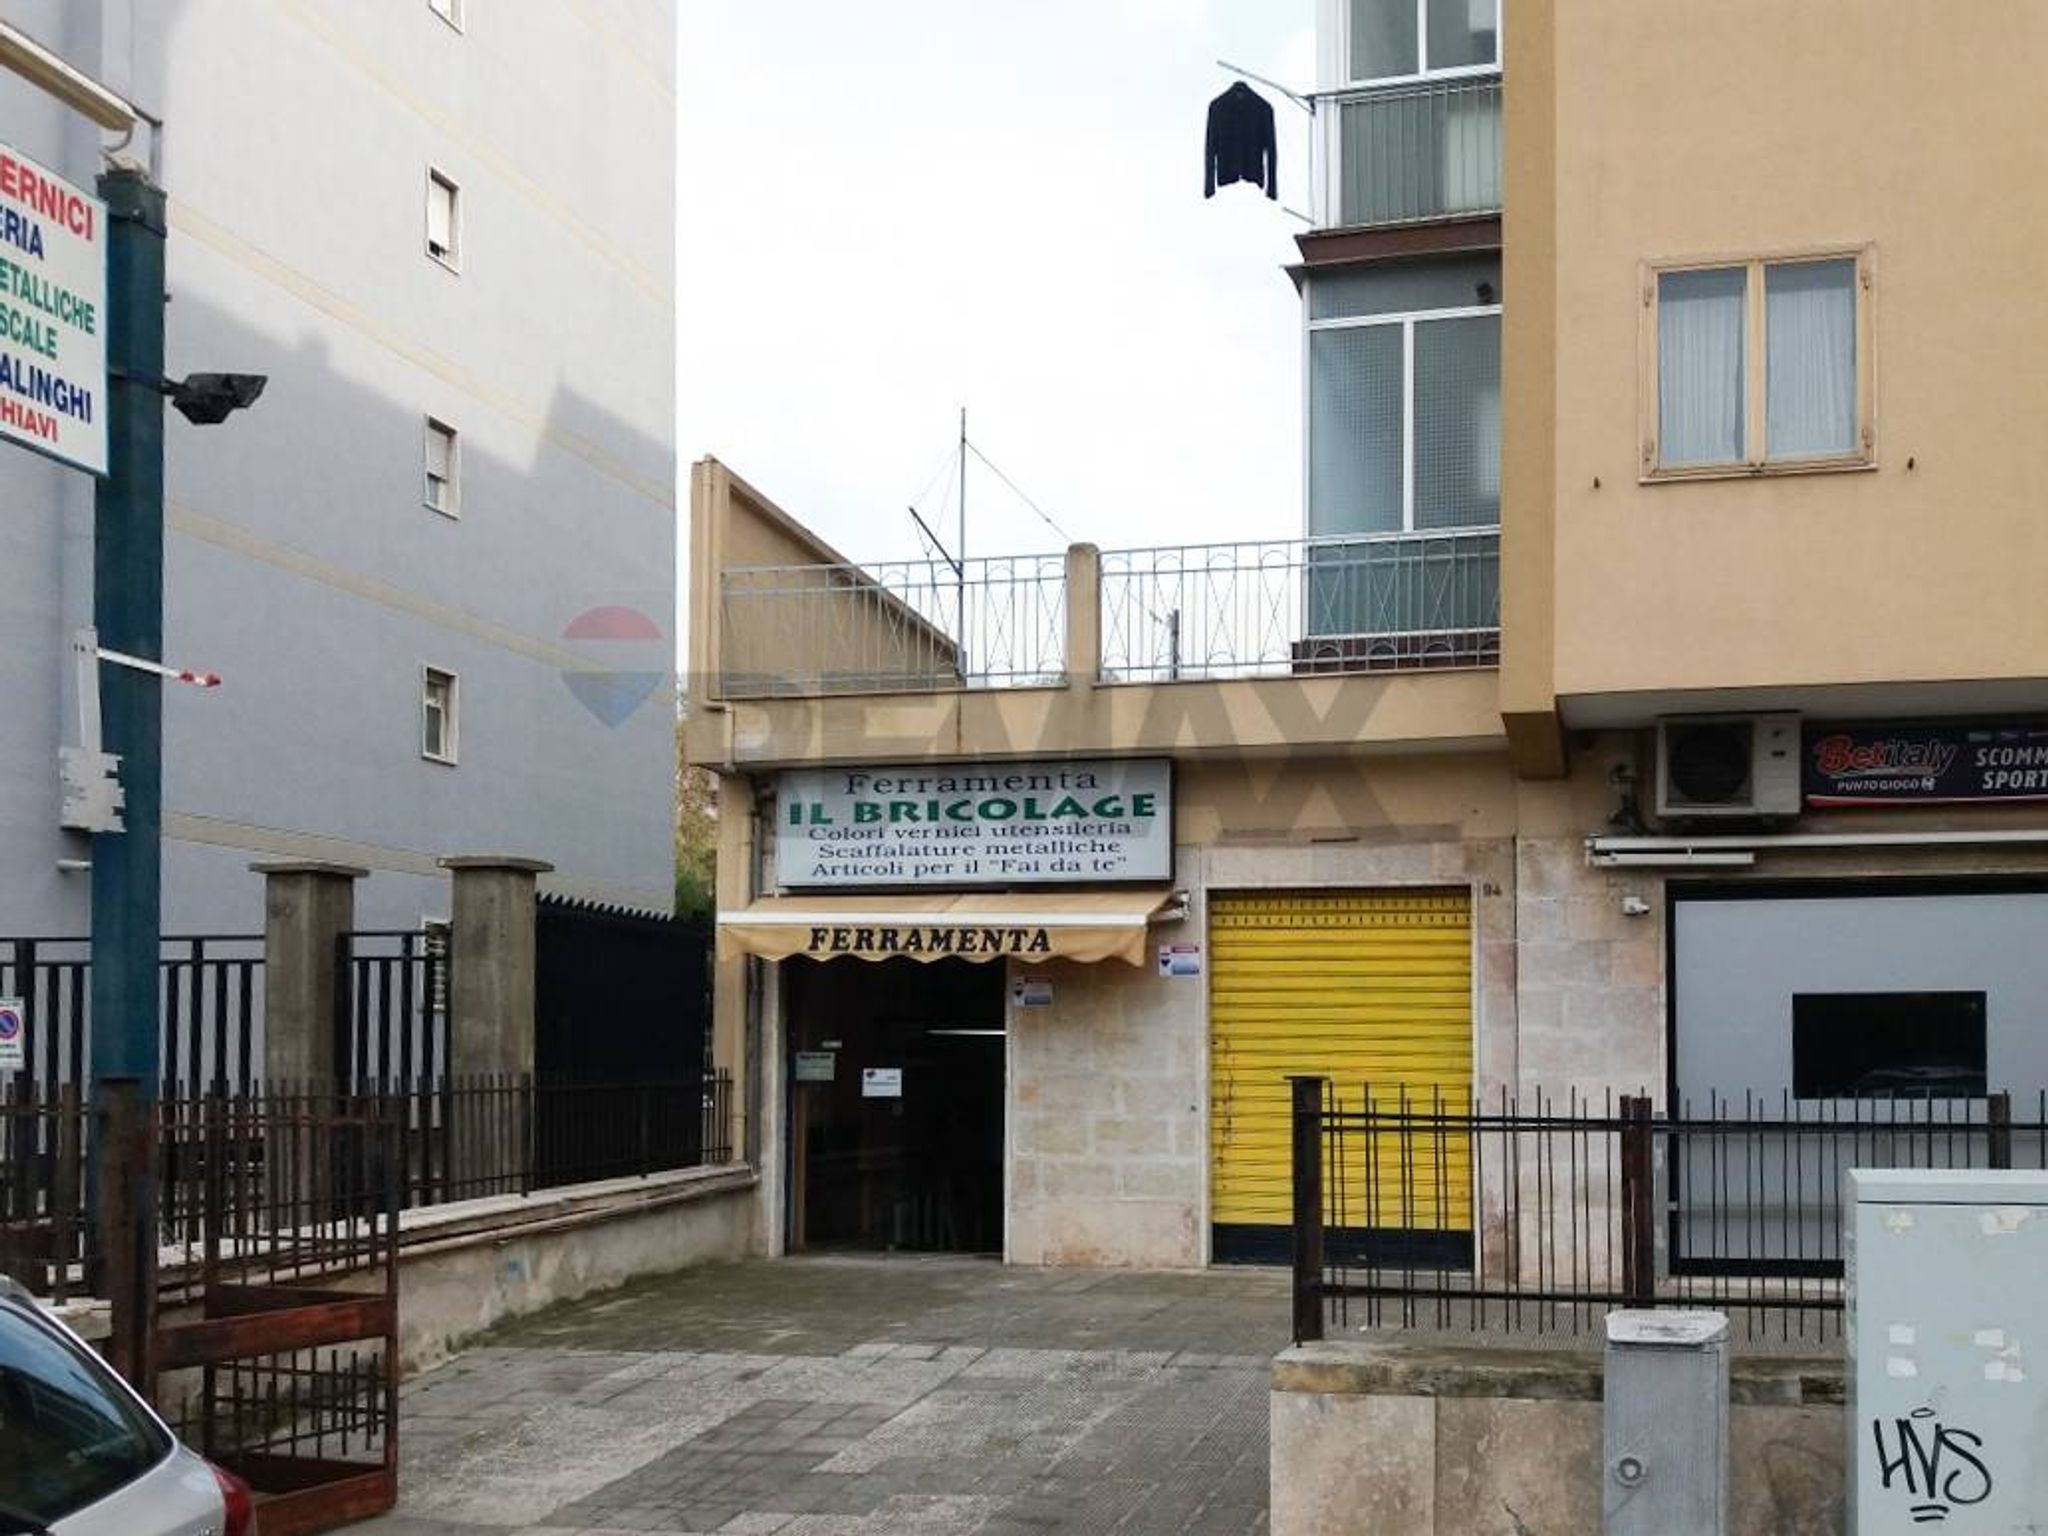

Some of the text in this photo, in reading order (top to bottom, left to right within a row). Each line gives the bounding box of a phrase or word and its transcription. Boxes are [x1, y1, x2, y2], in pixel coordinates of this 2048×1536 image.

[845, 773, 1099, 795] Ferramenta
[790, 793, 1156, 825] IL BRICOLAGE
[809, 821, 1131, 841] Colori vernici utensileria
[819, 839, 1121, 858] Scaffalature metalliche
[811, 862, 903, 877] Articoli
[914, 863, 954, 878] per
[964, 860, 979, 874] il
[1050, 857, 1081, 873] da
[808, 928, 1052, 953] FERRAMENTA
